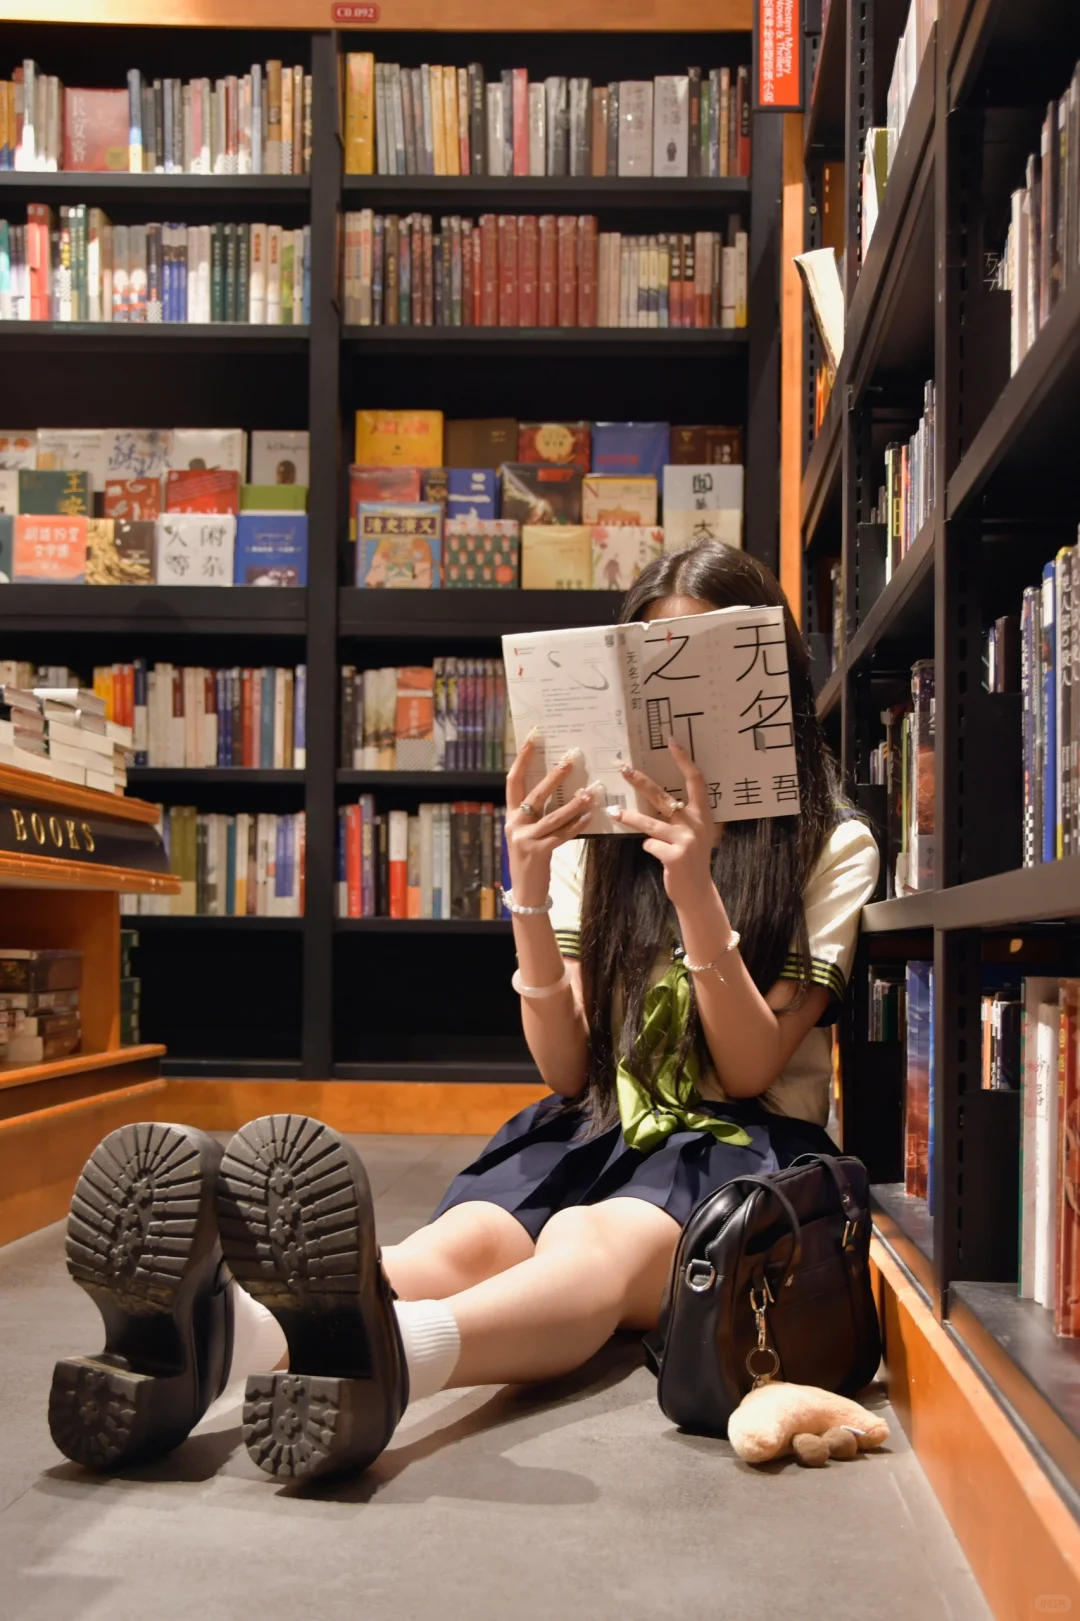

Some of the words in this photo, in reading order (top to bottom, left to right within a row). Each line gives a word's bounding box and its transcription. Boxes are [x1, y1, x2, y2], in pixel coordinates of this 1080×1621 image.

[775, 30, 785, 39] &
[775, 42, 785, 78] Thrillers
[783, 37, 794, 75] Mystery
[11, 808, 96, 853] BOOKS
